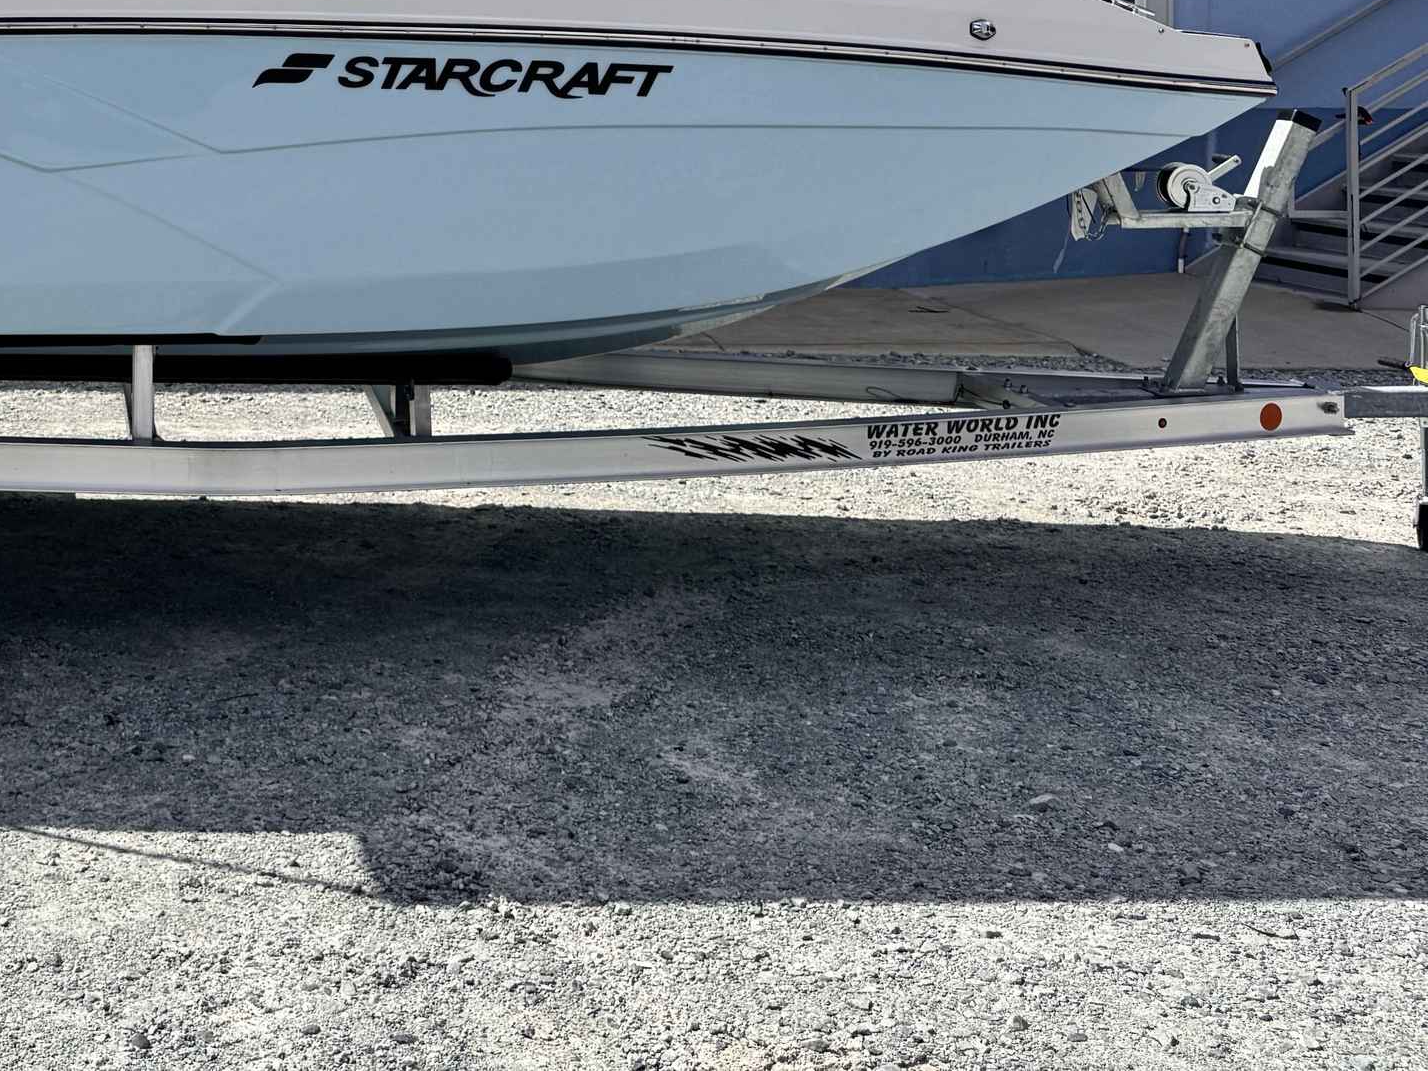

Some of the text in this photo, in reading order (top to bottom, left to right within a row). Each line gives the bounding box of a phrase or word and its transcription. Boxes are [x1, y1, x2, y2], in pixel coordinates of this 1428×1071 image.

[337, 56, 674, 99] STARCRAFT
[867, 414, 1061, 439] WATER WORLD INC
[869, 435, 962, 450] 919-596-3000
[1037, 429, 1055, 439] NC
[872, 439, 1051, 458] BY ROAD KING TRAILERS
